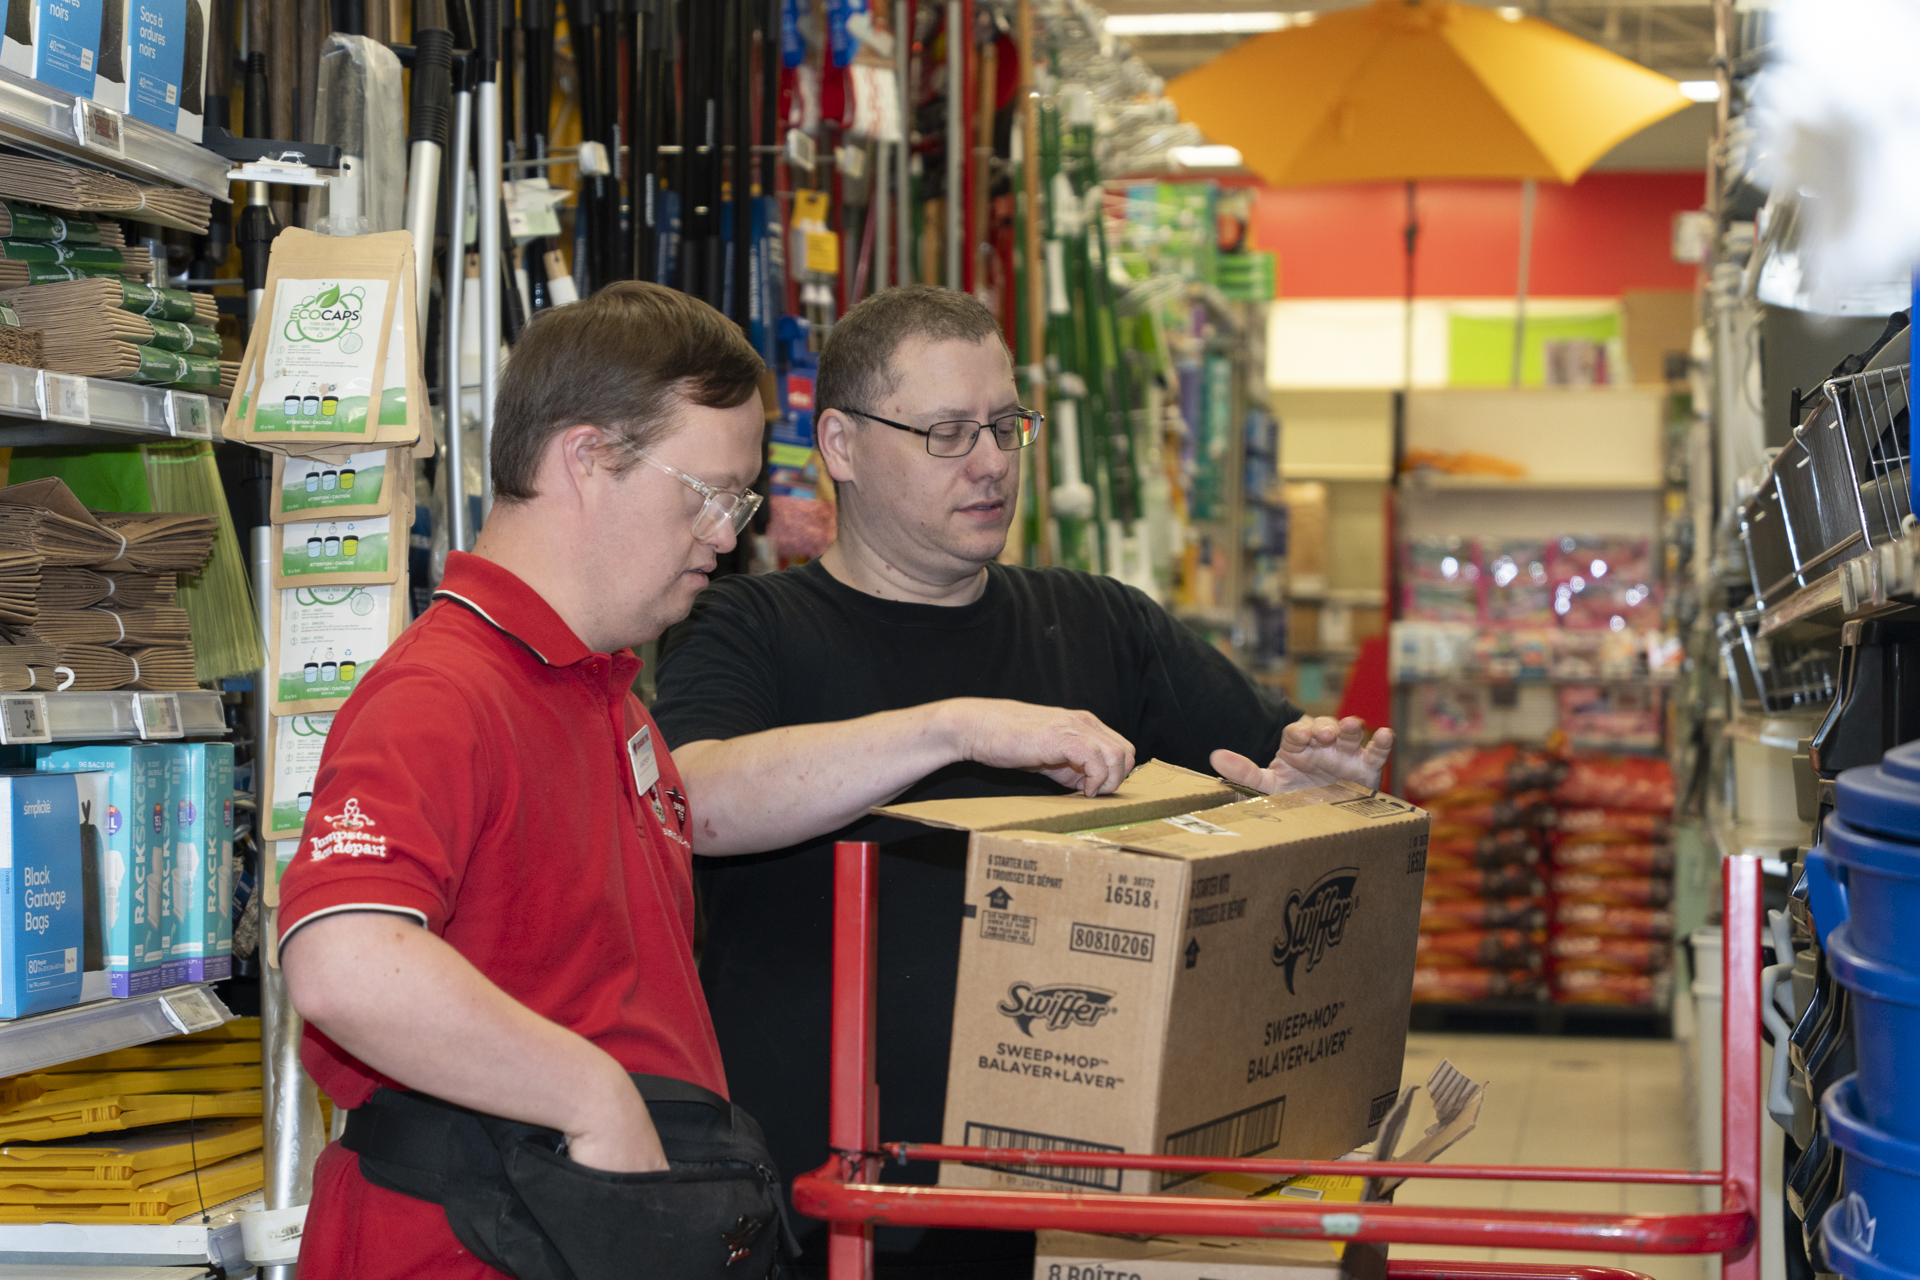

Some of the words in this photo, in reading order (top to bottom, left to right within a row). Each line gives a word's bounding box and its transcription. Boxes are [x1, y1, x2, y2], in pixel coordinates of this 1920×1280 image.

[50, 3, 69, 21] noirs
[140, 5, 157, 26] Sacs
[157, 13, 163, 28] à
[49, 39, 57, 52] 40
[139, 26, 166, 47] ordures
[139, 42, 156, 59] noirs
[289, 308, 360, 321] ECOCAPS
[23, 799, 51, 818] simplicité
[134, 760, 146, 924] RACKSACK
[207, 759, 218, 913] RACKSACK
[333, 840, 386, 857] départ
[993, 855, 1022, 870] STARTER
[1406, 849, 1427, 875] 16518
[24, 865, 51, 887] Black
[992, 869, 1025, 884] TROUSSES
[1026, 873, 1036, 884] DE
[1036, 873, 1063, 890] DÉPART
[25, 888, 66, 911] Garbage
[1105, 885, 1152, 908] 16518
[25, 911, 50, 935] Bags
[1272, 887, 1354, 973] Swiffer
[1074, 928, 1149, 957] 80810206
[28, 960, 38, 974] 80
[998, 982, 1108, 1029] Swiffer
[1048, 1264, 1062, 1280] 8
